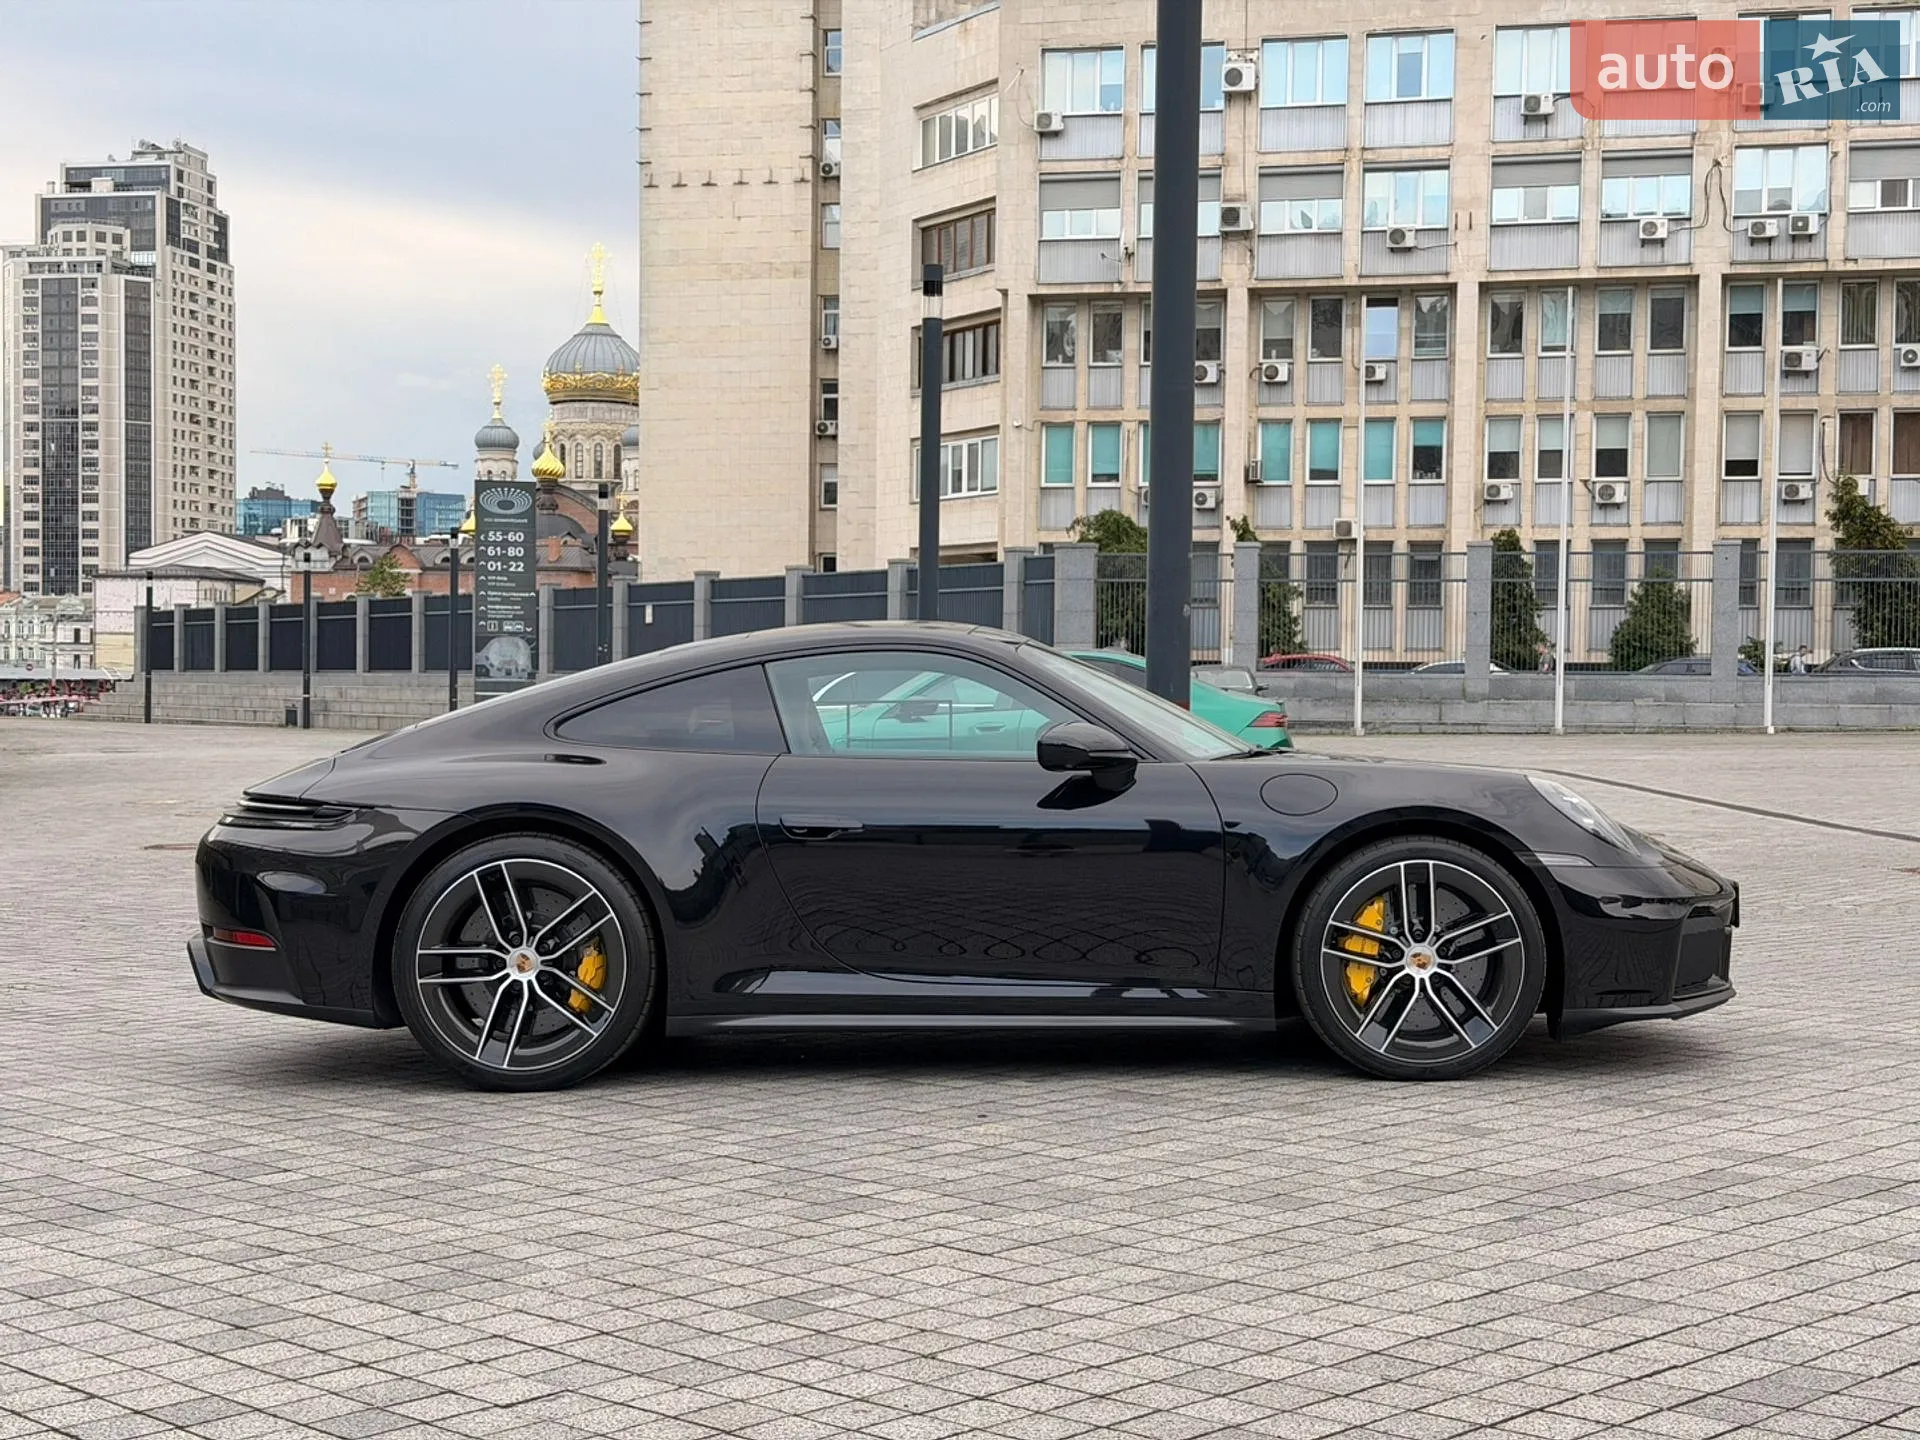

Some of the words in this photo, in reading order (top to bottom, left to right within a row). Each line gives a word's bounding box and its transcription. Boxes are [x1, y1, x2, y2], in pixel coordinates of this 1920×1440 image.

[487, 531, 524, 542] 55-60
[487, 546, 524, 557] 61-80
[487, 561, 525, 572] 01-22
